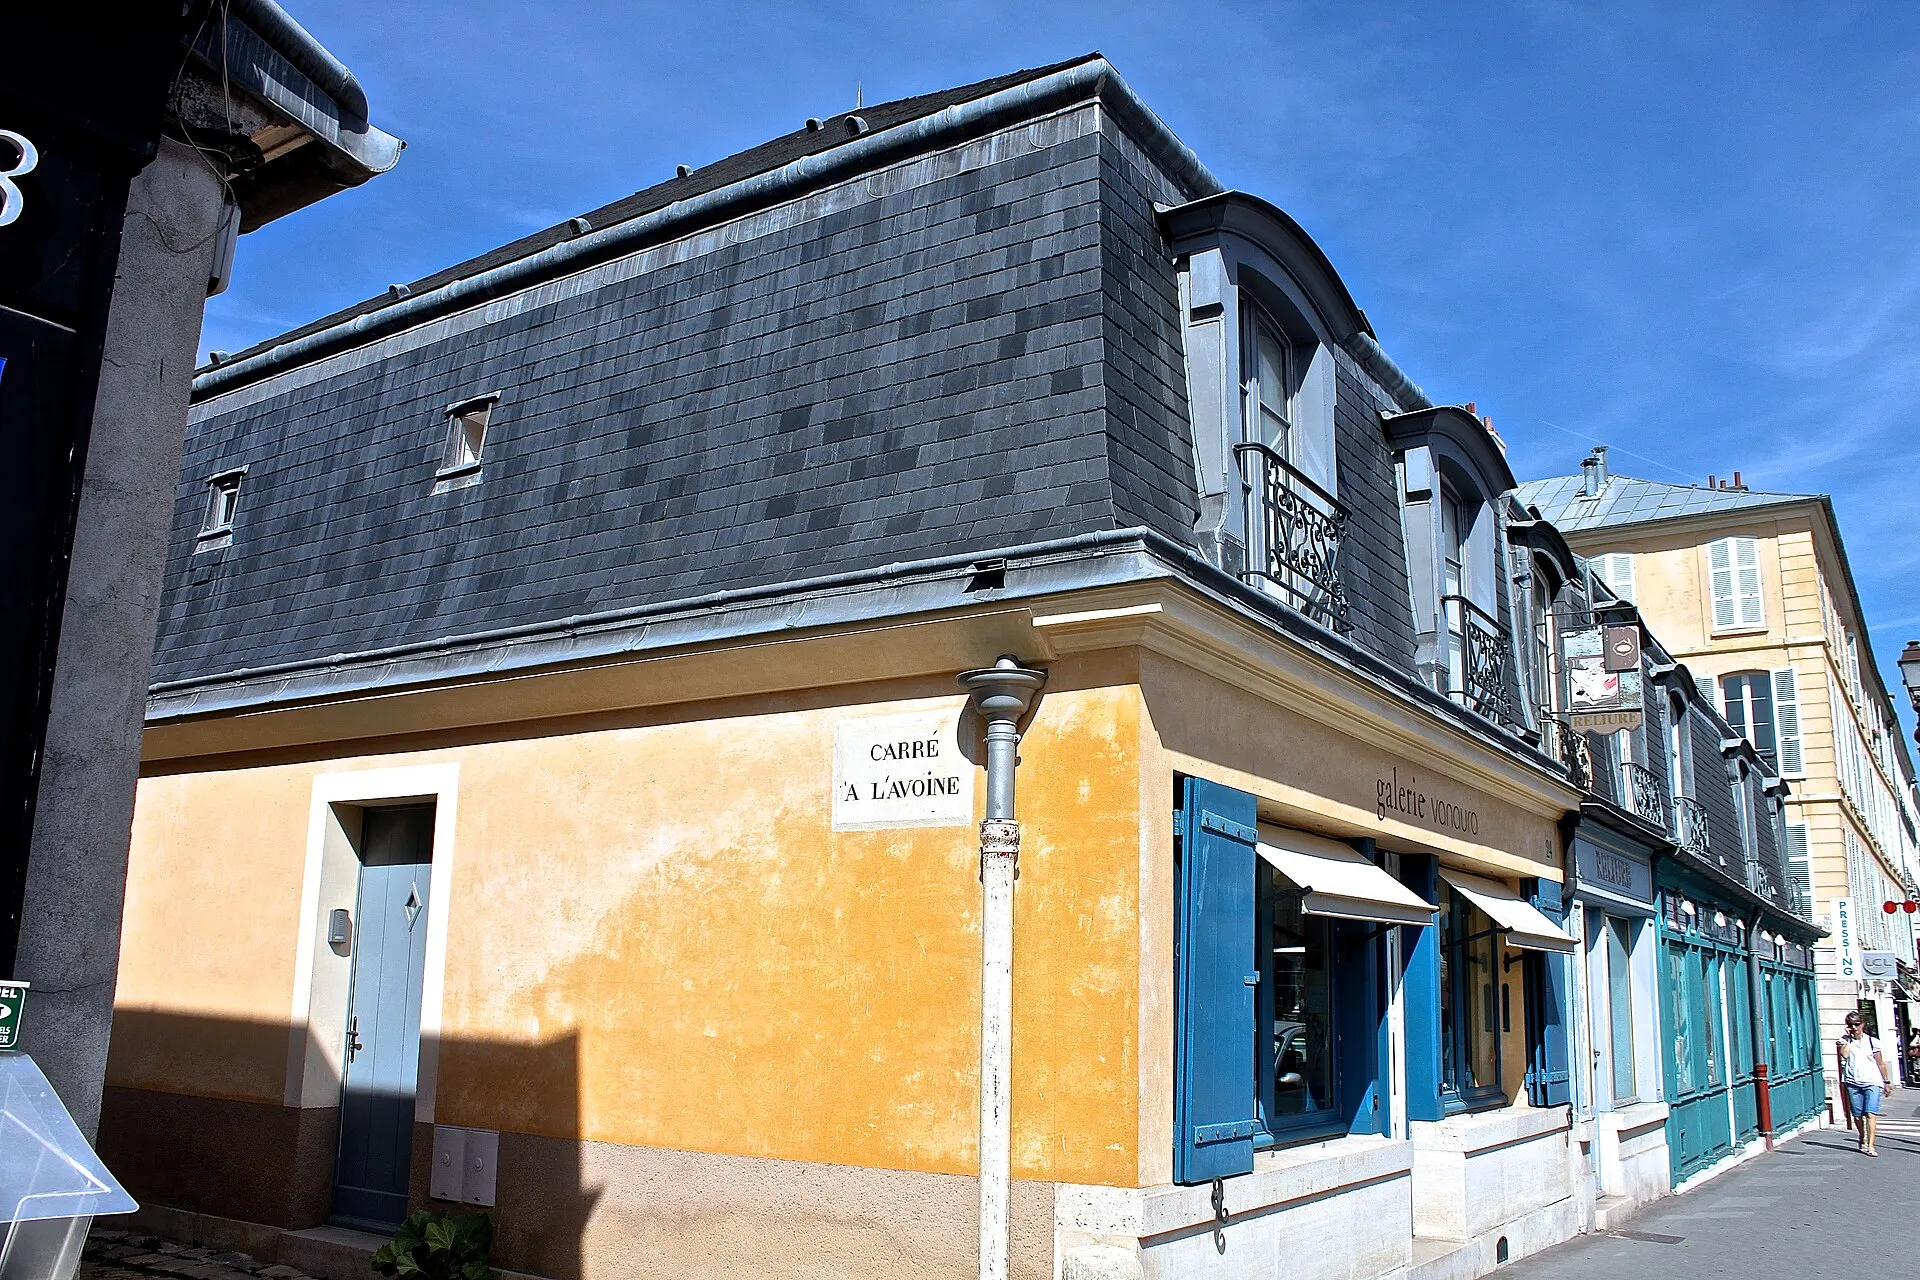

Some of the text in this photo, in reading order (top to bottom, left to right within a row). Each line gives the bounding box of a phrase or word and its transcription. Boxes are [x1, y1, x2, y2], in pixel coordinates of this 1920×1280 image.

[1573, 712, 1638, 727] RELIURE
[870, 730, 939, 762] CARRÉ
[1376, 766, 1426, 821] galerie
[1839, 901, 1853, 976] PRESSING
[1865, 958, 1893, 967] LCL
